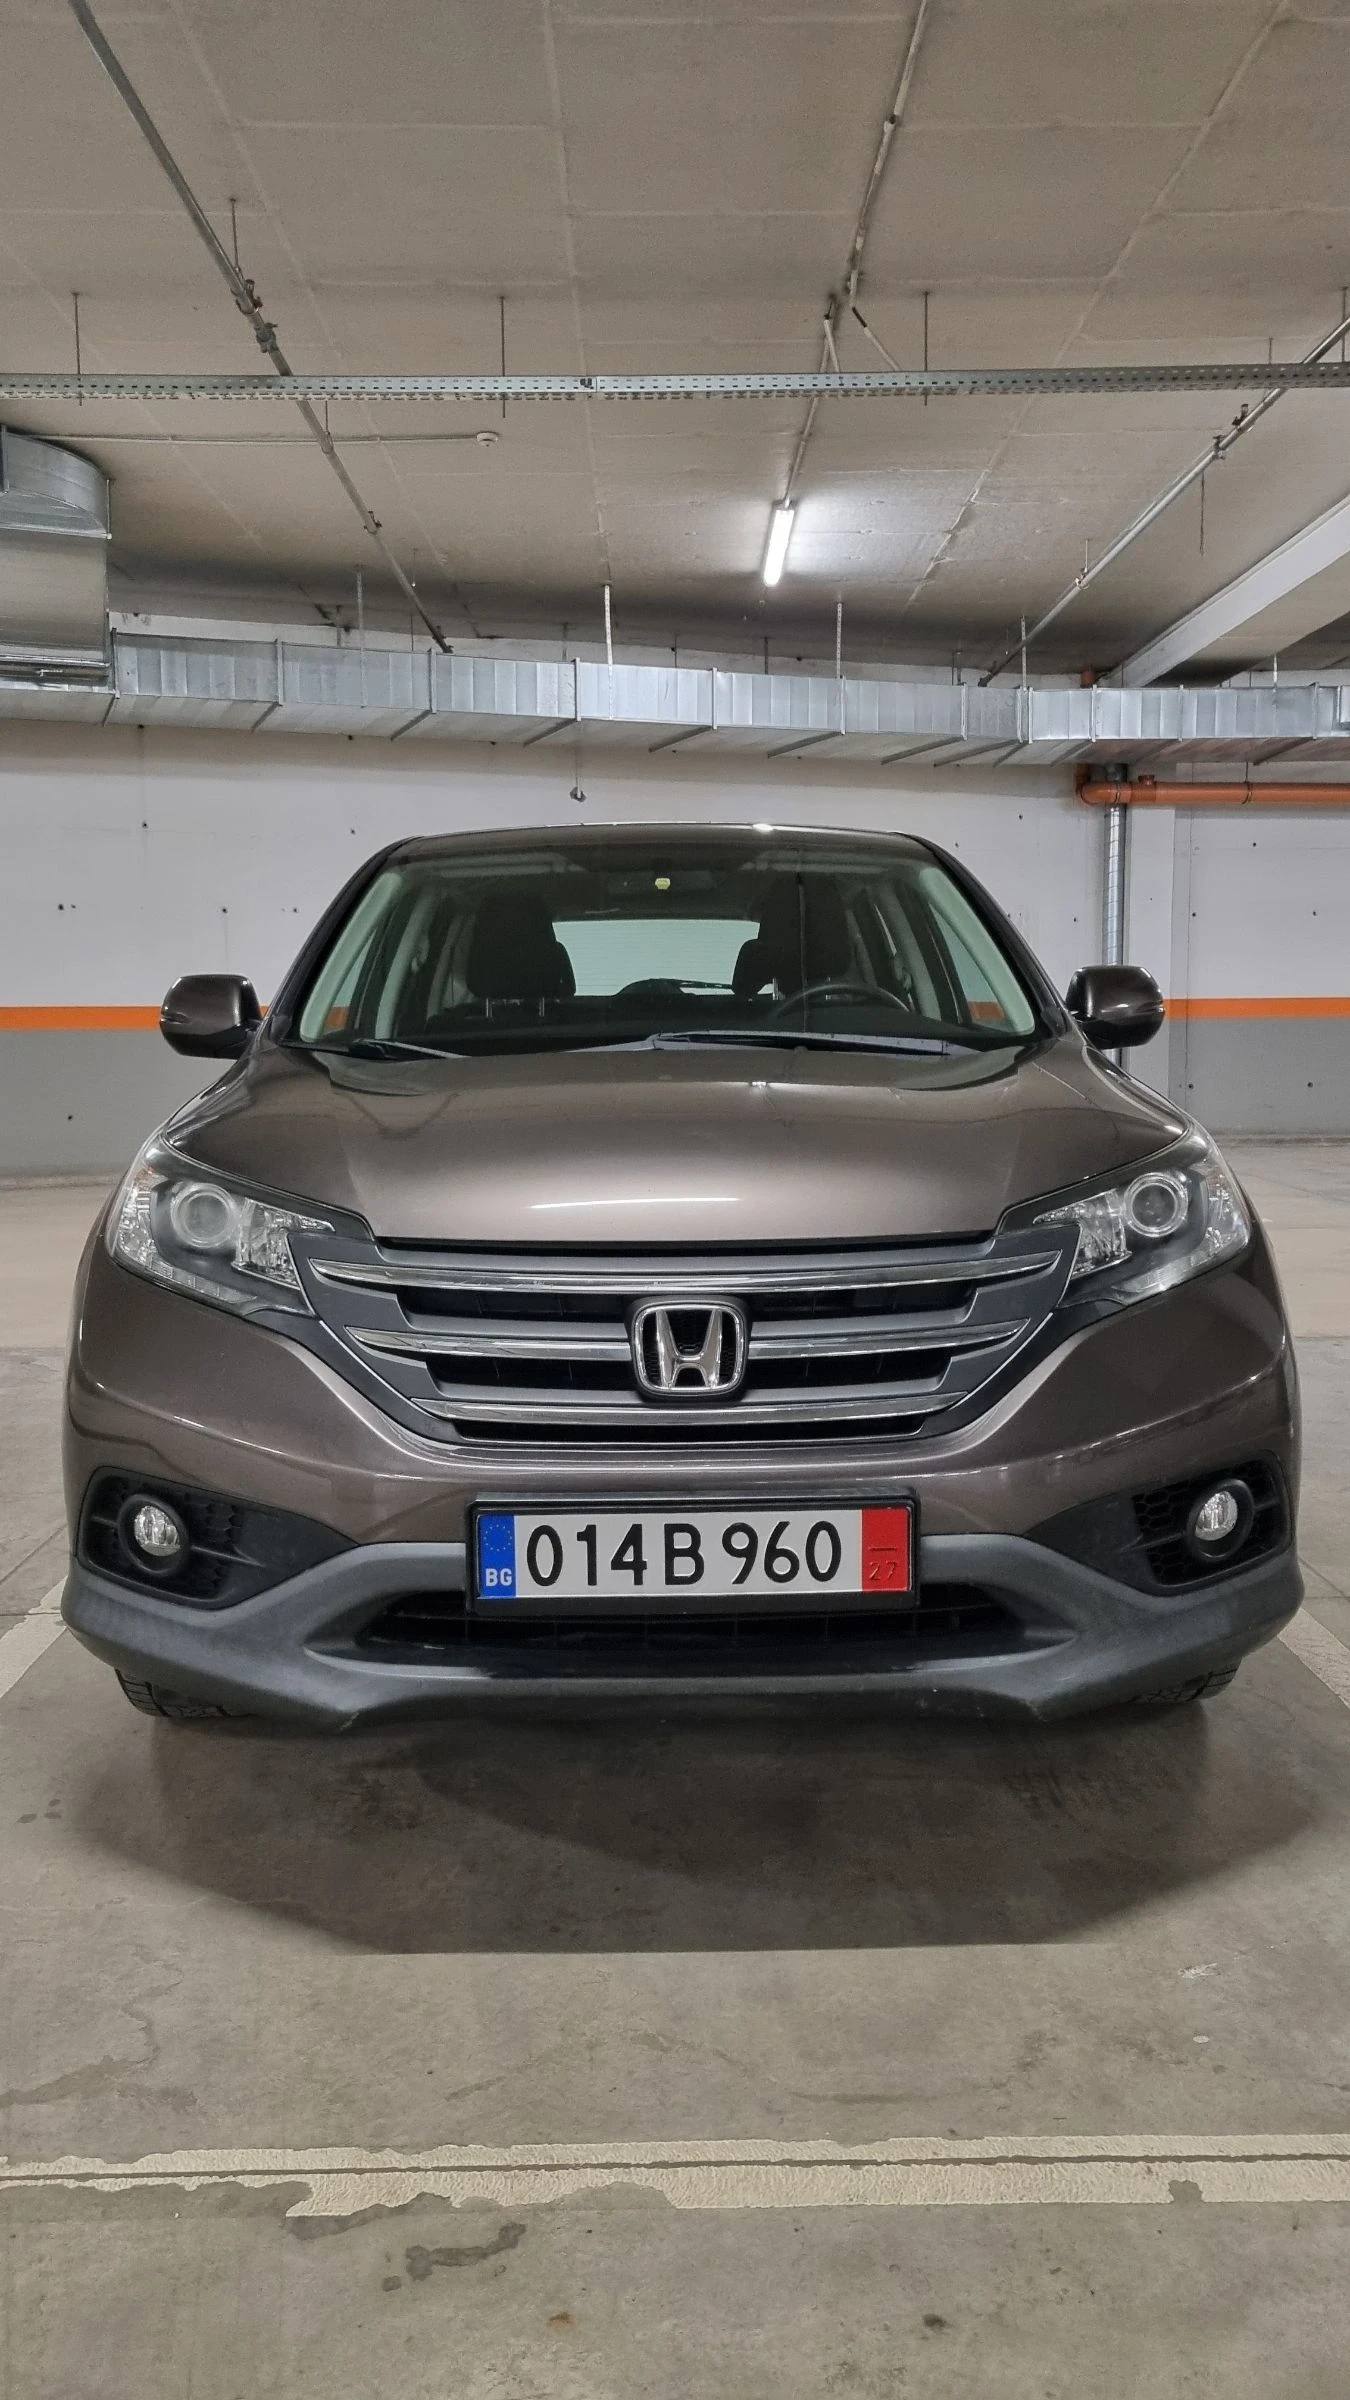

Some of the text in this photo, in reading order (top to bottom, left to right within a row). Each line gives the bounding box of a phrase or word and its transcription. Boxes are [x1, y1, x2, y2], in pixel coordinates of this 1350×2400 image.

[655, 1309, 722, 1388] H
[485, 1568, 512, 1587] BG
[869, 1561, 897, 1581] 27
